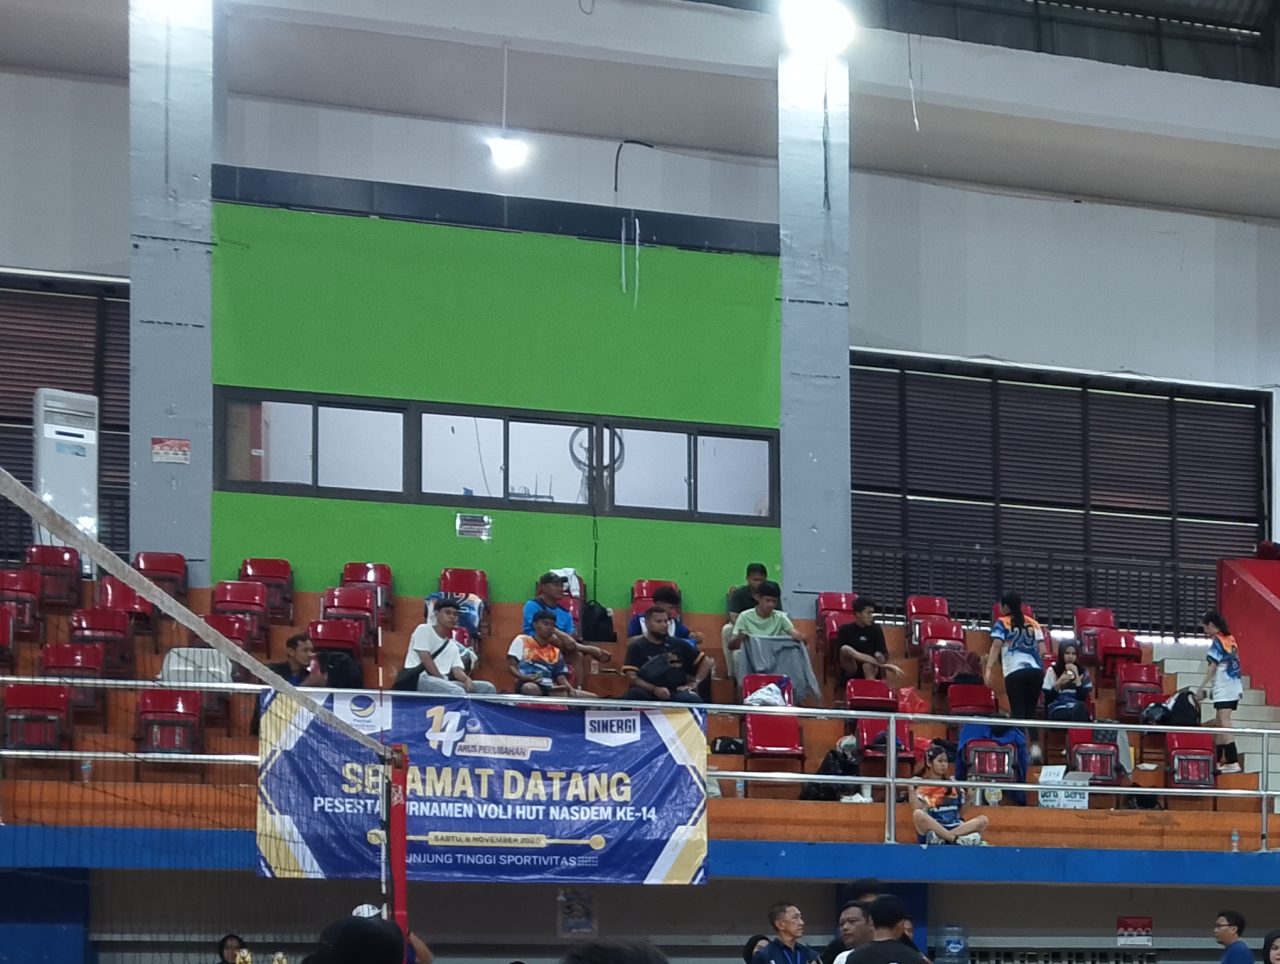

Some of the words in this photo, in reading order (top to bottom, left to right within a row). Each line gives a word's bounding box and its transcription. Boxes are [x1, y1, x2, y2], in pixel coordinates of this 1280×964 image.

[589, 718, 637, 734] SINERGI
[457, 743, 478, 753] ARUS
[479, 745, 526, 756] PERUBAHAN
[503, 769, 632, 802] DATANG
[405, 800, 473, 818] RNAMEN
[477, 803, 512, 819] VOLI
[515, 805, 546, 820] HUT
[549, 805, 612, 821] NASDEM
[615, 806, 657, 822] KE-14
[472, 836, 519, 844] NOVEMBER
[405, 853, 453, 864] UNJUNG
[455, 853, 496, 865] TINGGI
[499, 854, 577, 867] SPORTIVITAS
